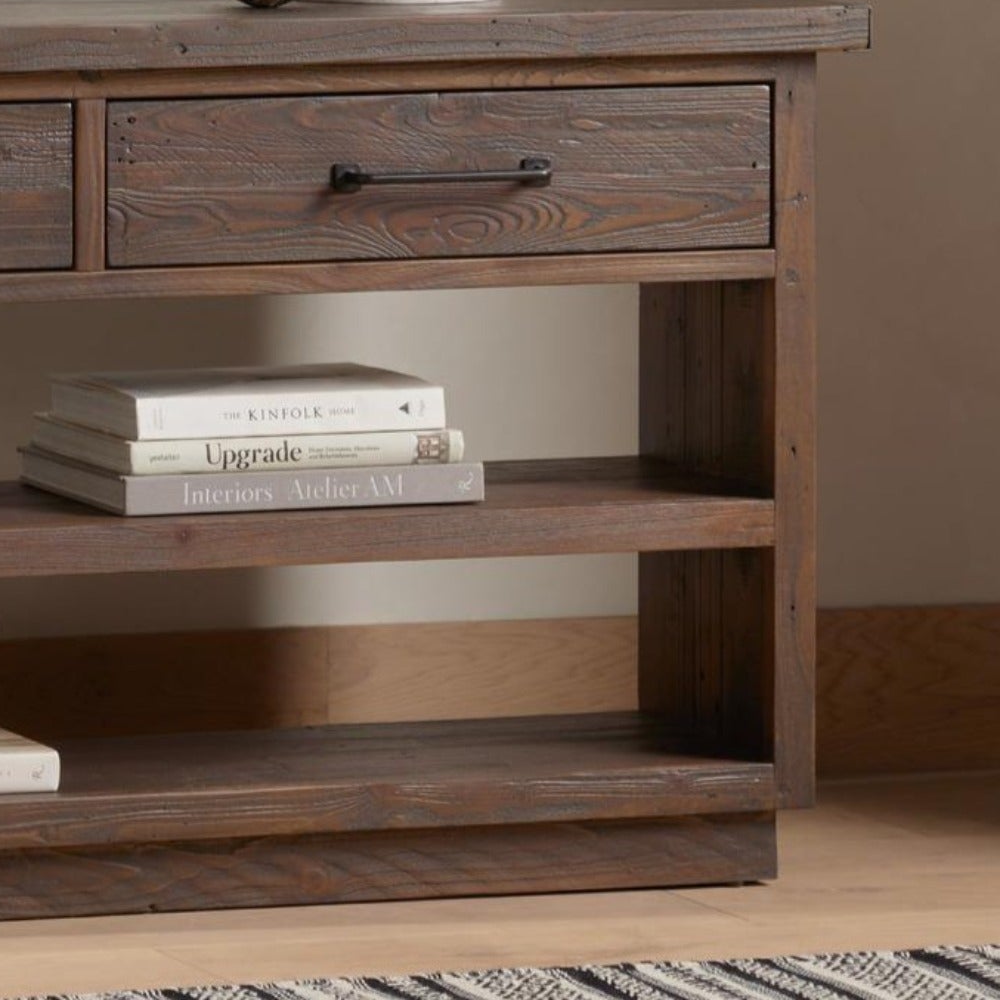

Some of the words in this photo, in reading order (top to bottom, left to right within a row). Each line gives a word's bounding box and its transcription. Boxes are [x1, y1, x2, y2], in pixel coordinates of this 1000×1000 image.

[248, 406, 323, 421] KINFOLK
[205, 440, 303, 470] Upgrade
[183, 482, 274, 505] Interiors
[288, 477, 361, 500] Atelier
[366, 474, 404, 497] AM
